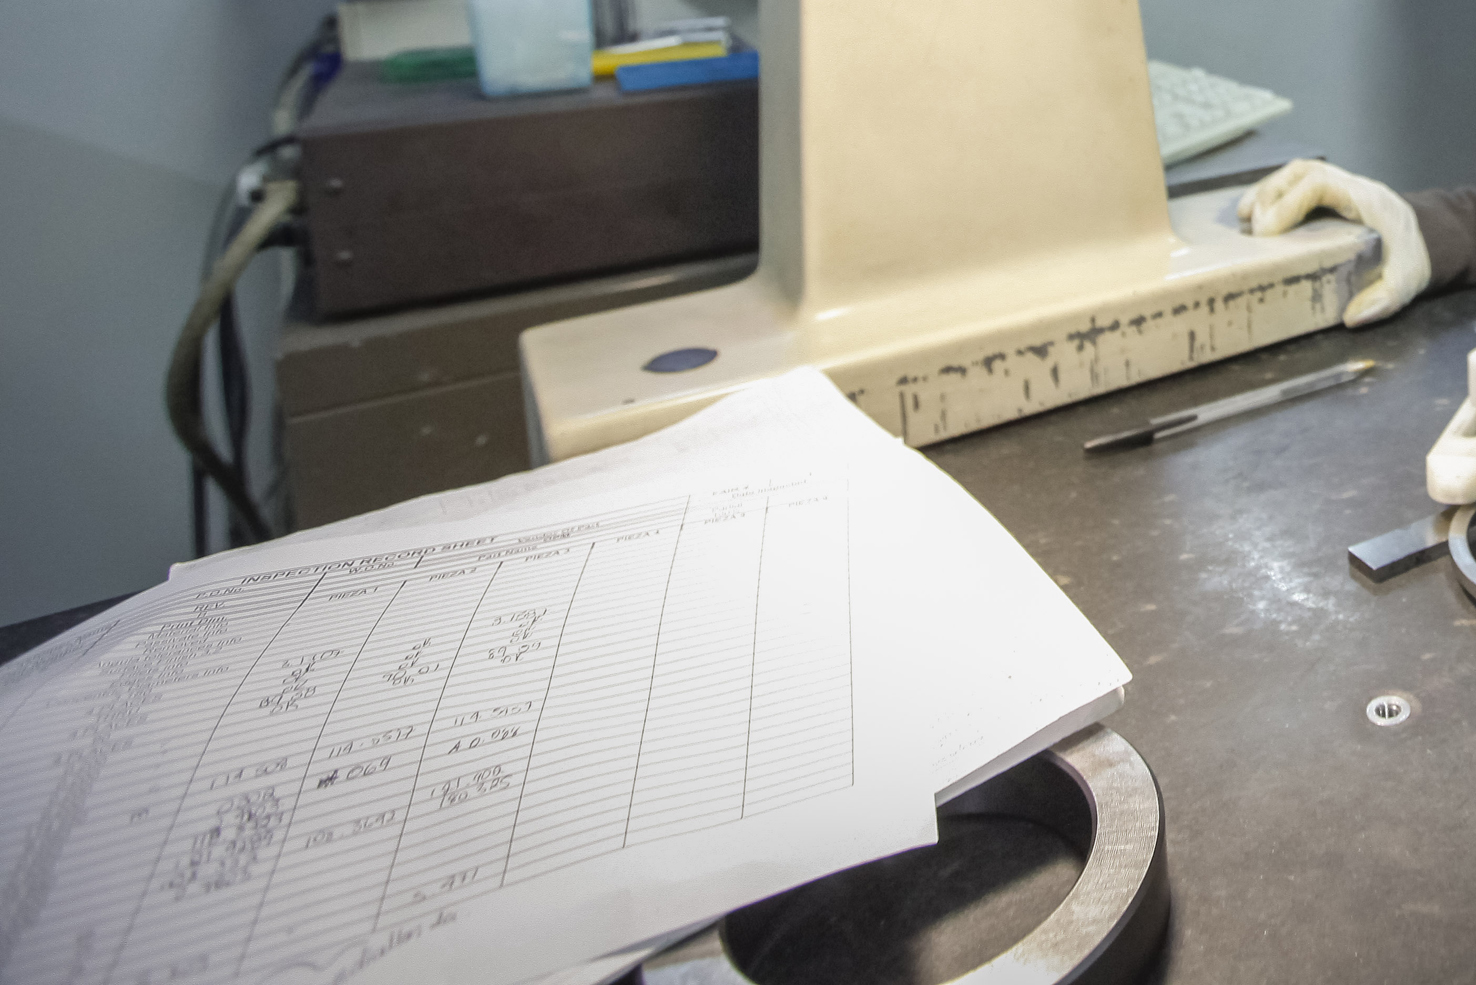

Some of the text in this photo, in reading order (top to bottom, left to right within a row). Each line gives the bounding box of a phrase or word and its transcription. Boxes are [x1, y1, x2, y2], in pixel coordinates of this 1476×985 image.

[616, 531, 650, 543] PIEZA
[241, 536, 497, 584] INSPECTION RECORD SHEET
[525, 549, 559, 562] PIEZA
[429, 569, 466, 582] PIEZA
[328, 587, 367, 601] PIEZA
